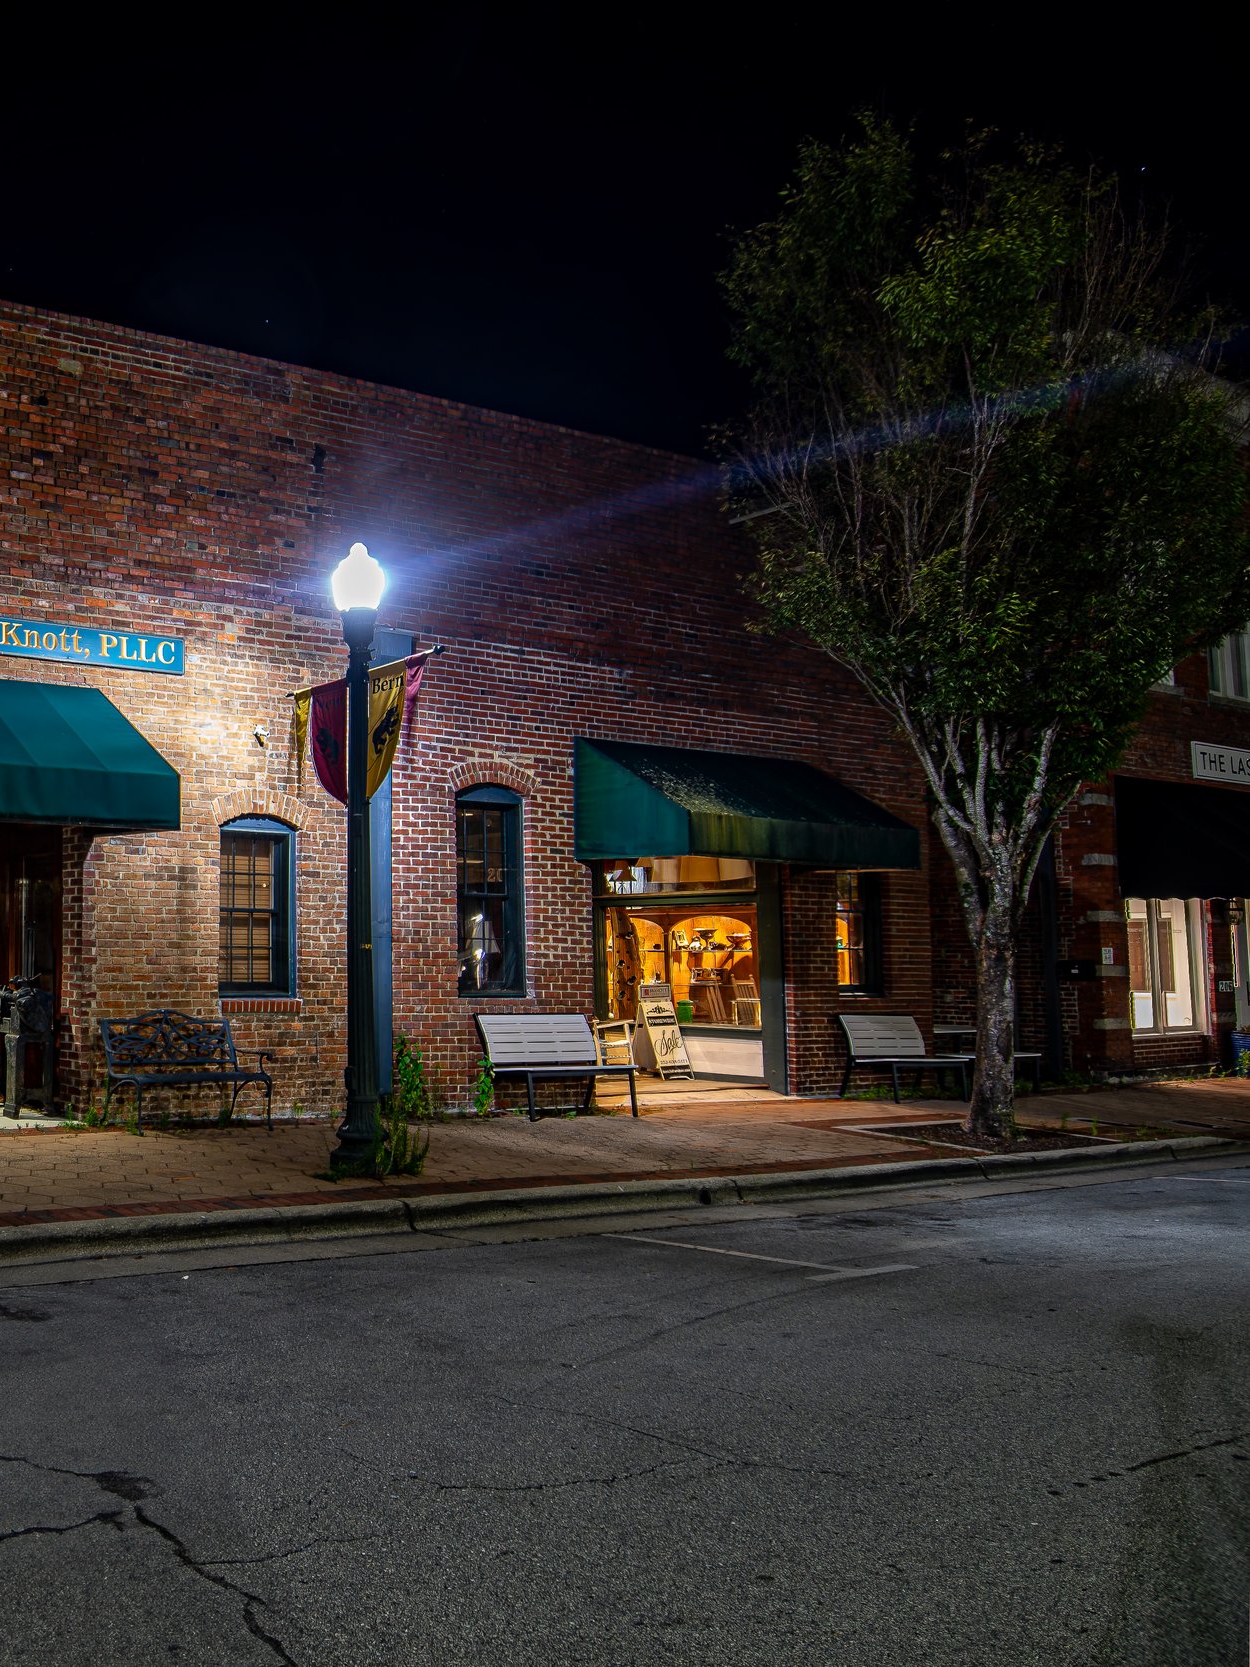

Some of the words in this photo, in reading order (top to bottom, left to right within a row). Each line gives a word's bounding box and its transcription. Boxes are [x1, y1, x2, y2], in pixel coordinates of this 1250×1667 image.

[0, 620, 91, 659] Knott,
[98, 633, 176, 665] PLLC
[371, 676, 404, 694] Bern
[1199, 751, 1226, 773] THE
